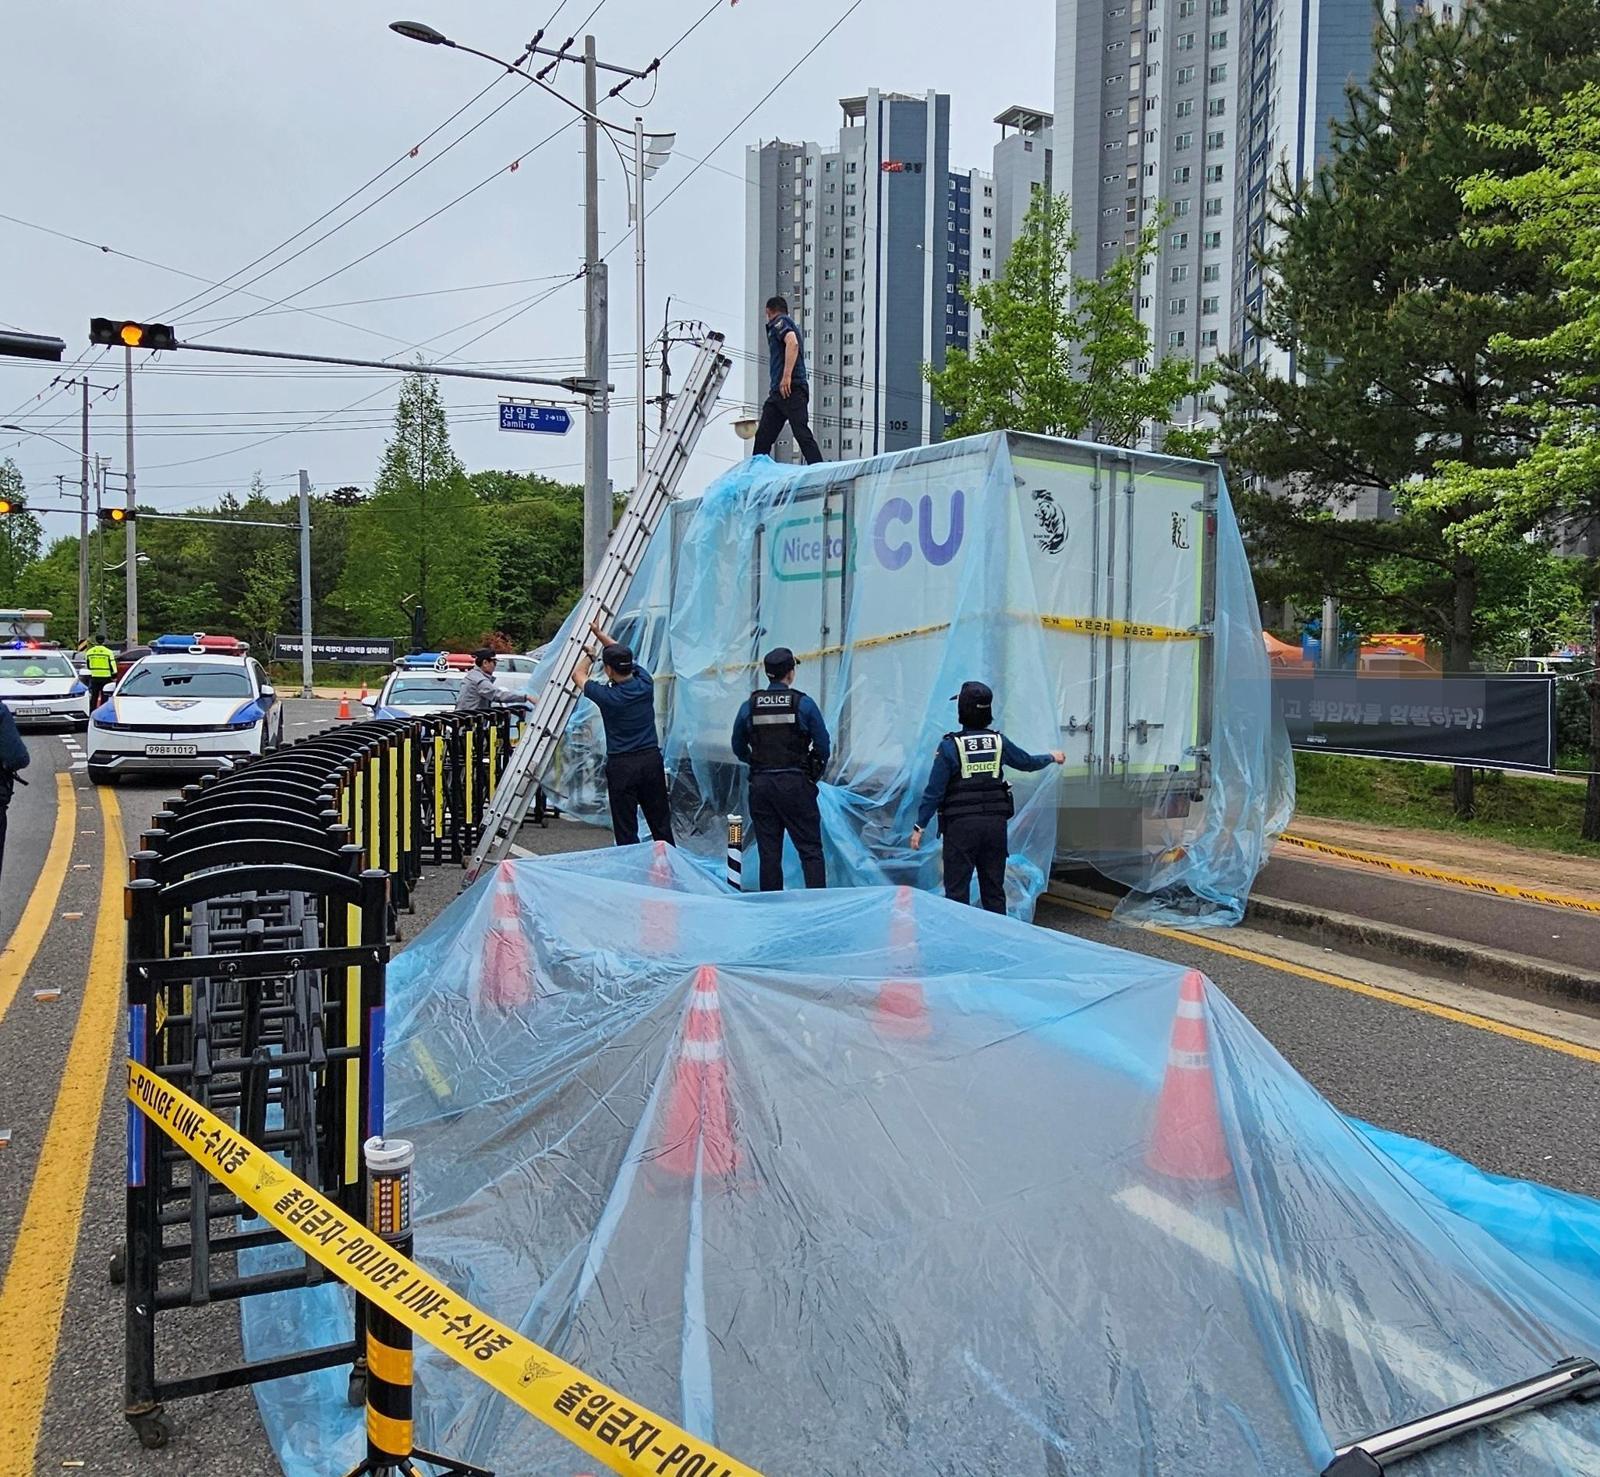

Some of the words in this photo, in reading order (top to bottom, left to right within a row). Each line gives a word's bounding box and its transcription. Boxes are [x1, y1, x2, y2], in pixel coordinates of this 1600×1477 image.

[503, 406, 540, 420] 삼일로
[502, 419, 535, 430] Samil-ro
[889, 420, 908, 430] 105
[874, 490, 965, 571] CU
[784, 537, 820, 563] Nice
[826, 534, 843, 559] to
[757, 695, 791, 704] POLICE
[1308, 698, 1383, 725] 책임자를
[1390, 704, 1484, 730] 엄벌하라!
[966, 763, 997, 772] POLICE
